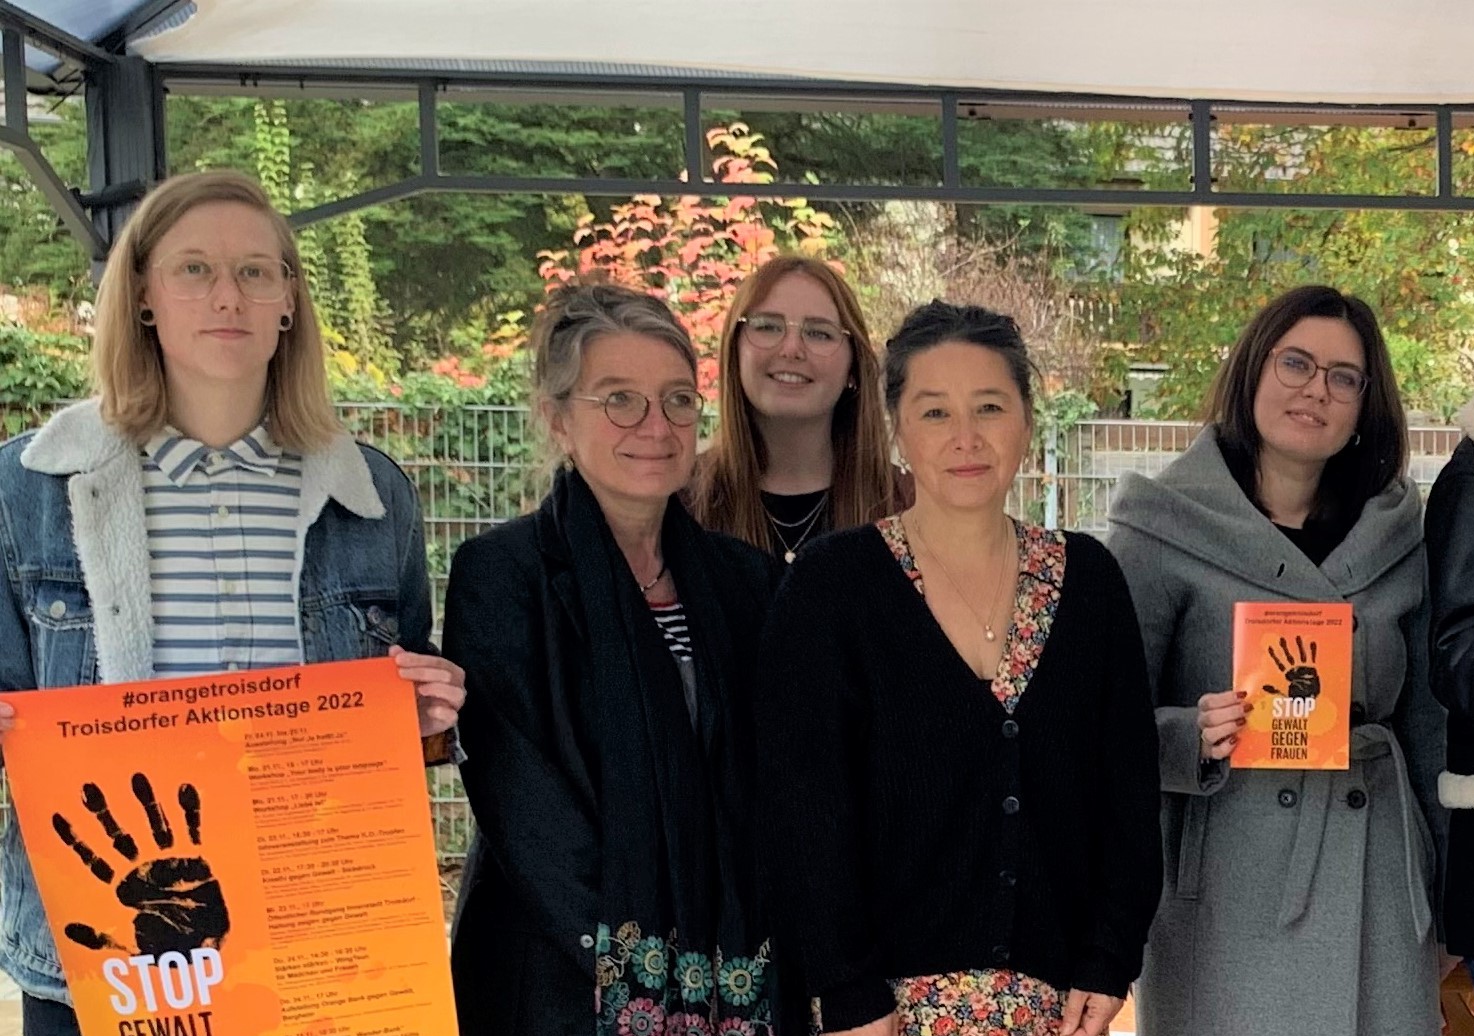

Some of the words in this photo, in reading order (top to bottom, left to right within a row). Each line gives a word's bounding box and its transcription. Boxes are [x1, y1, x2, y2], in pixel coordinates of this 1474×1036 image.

[123, 673, 302, 708] #orangetroisdorf
[58, 710, 180, 738] Troisdorfer
[184, 699, 311, 726] Aktionstage
[317, 691, 365, 712] 2022
[1272, 697, 1316, 718] STOP
[1271, 718, 1308, 730] GEWALT
[1271, 731, 1308, 746] GEGEN
[1270, 747, 1307, 760] FRAUEN
[102, 947, 224, 1016] STOP
